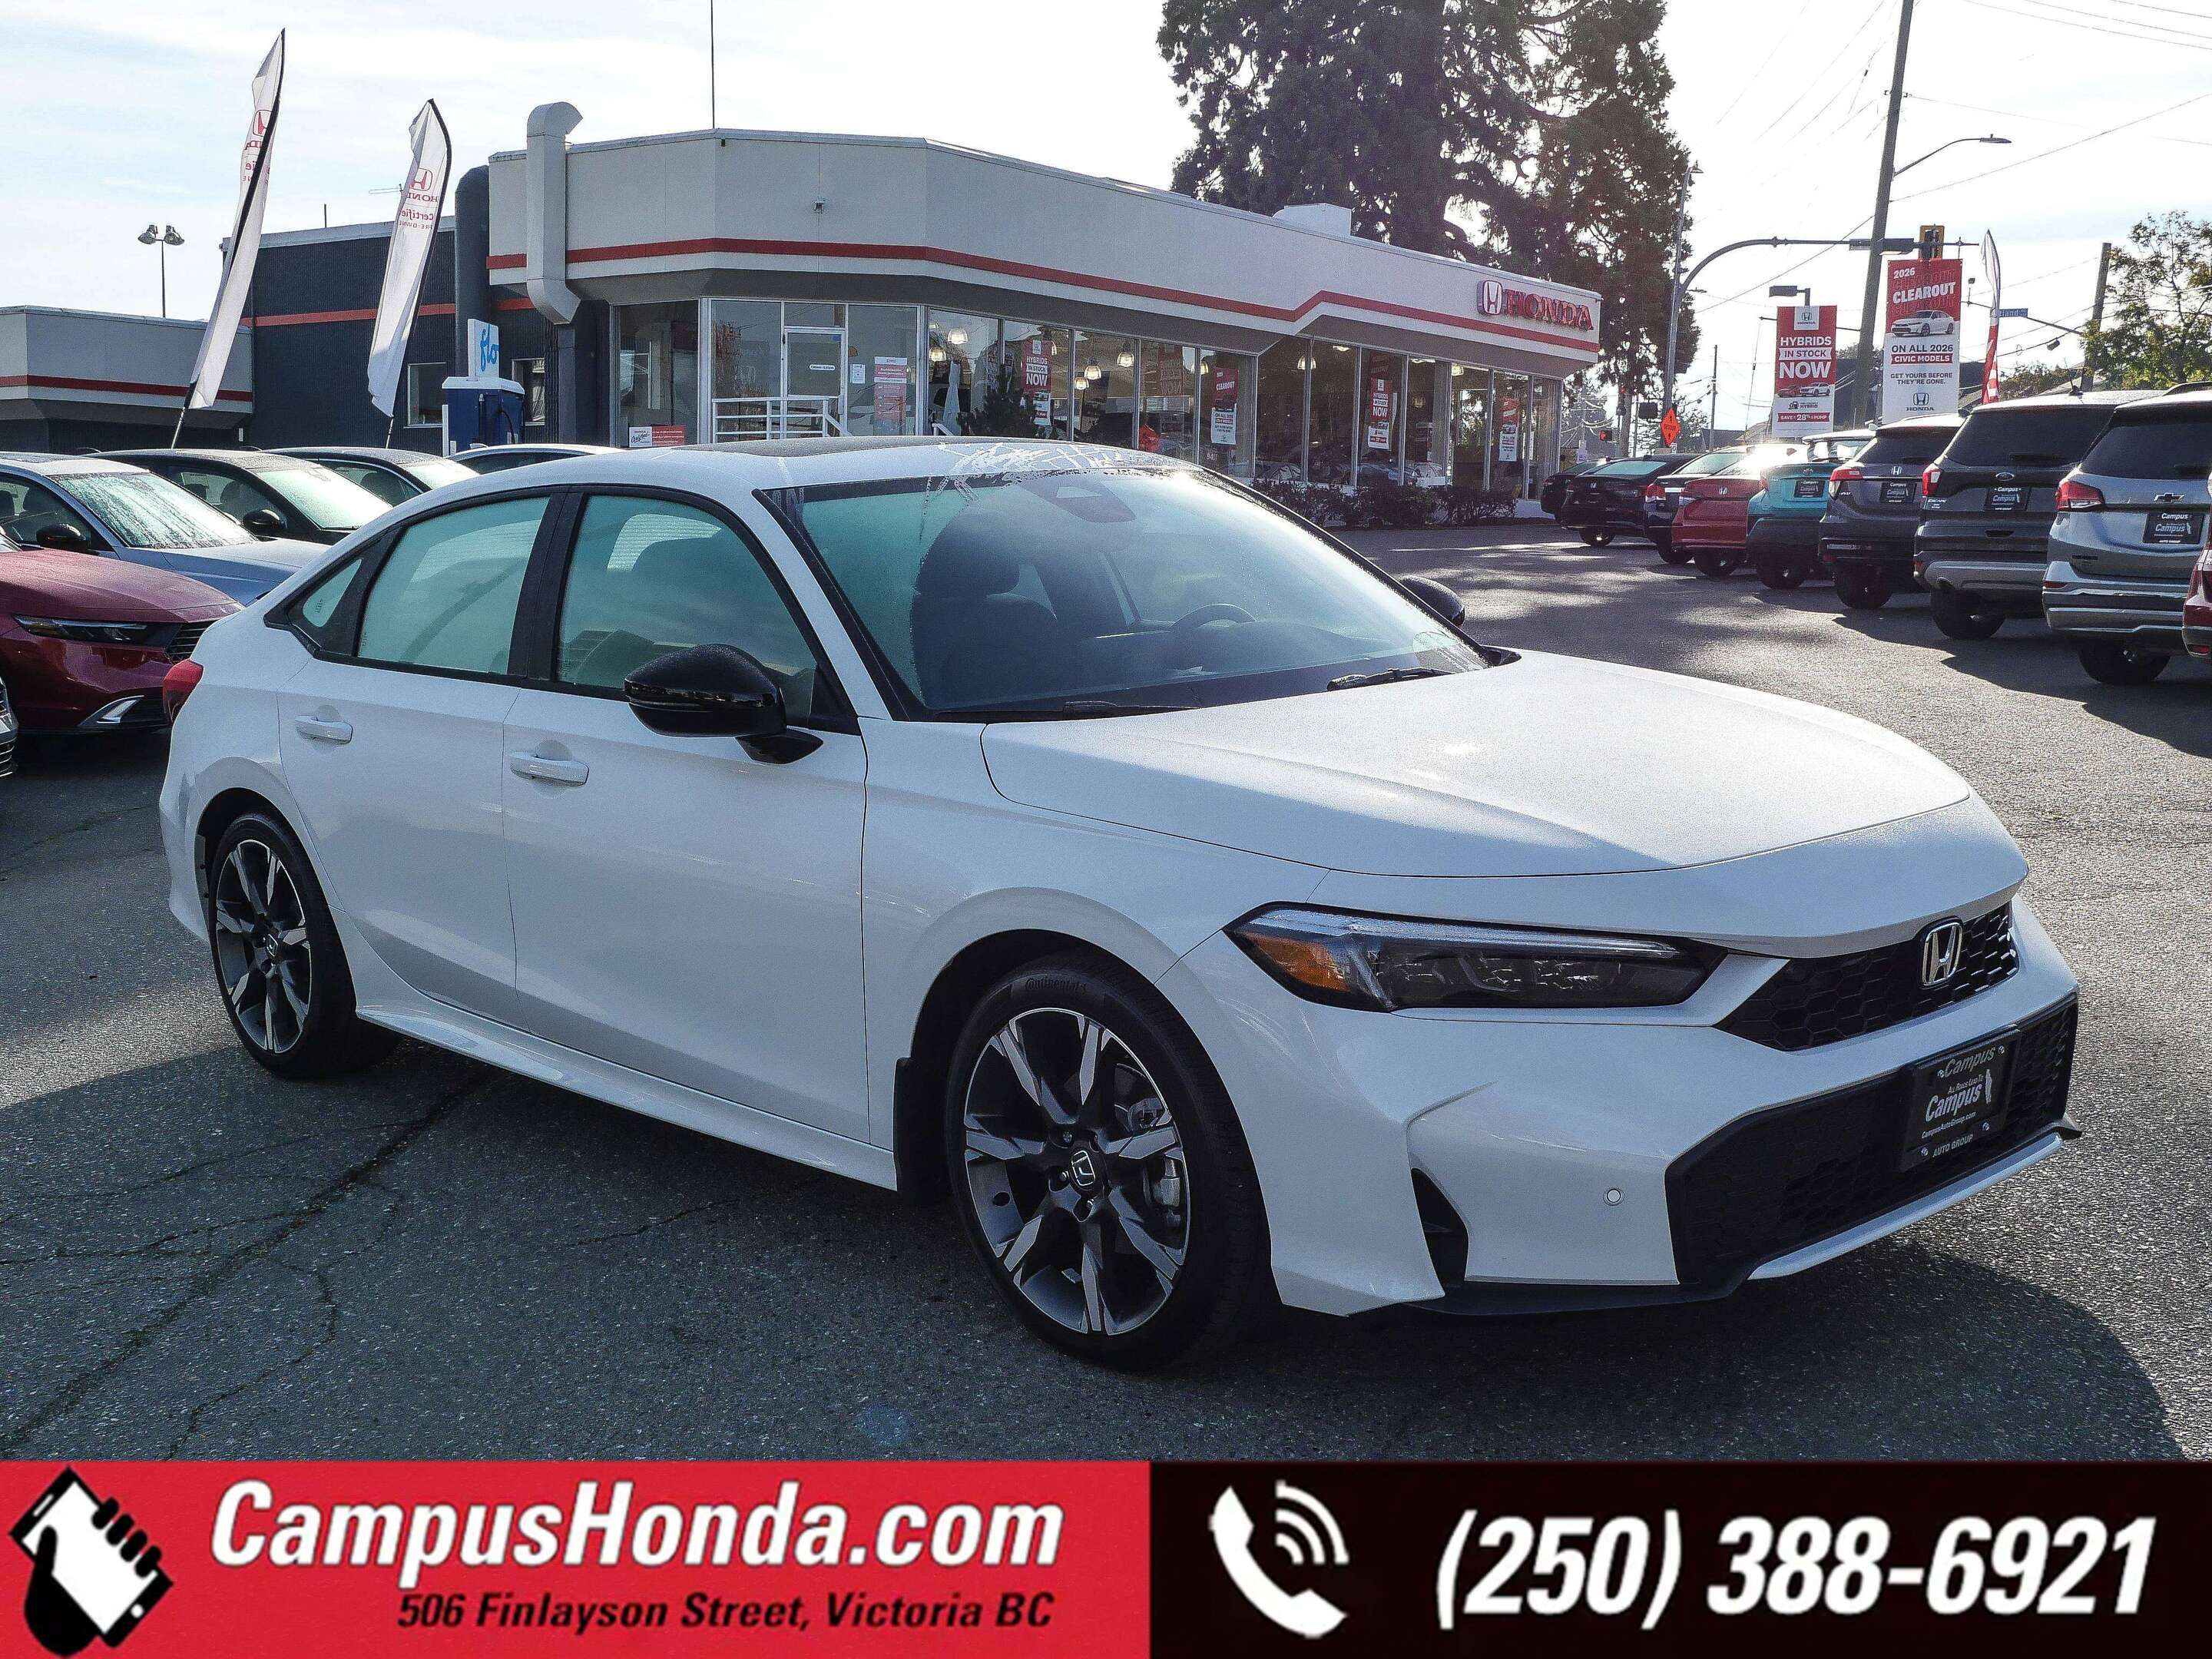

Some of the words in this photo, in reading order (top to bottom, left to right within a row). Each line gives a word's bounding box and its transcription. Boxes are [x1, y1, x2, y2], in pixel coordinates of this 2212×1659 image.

[1893, 267, 1916, 279] 2026
[1892, 282, 1955, 304] CLEAROUT
[1505, 289, 1594, 330] HONDA
[1780, 336, 1832, 346] HYBRIDS
[1909, 344, 1928, 353] ALL
[1930, 344, 1953, 353] 2026
[1026, 356, 1048, 364] HYBRIDS
[1779, 361, 1832, 379] NOW
[1026, 373, 1048, 386] NOW
[1373, 406, 1388, 417] NOW
[2155, 523, 2186, 533] Campus
[1944, 1047, 1996, 1078] Campus
[1926, 1084, 1982, 1122] Campus
[1932, 1143, 1950, 1158] AUTO
[1951, 1134, 1974, 1150] GROUP
